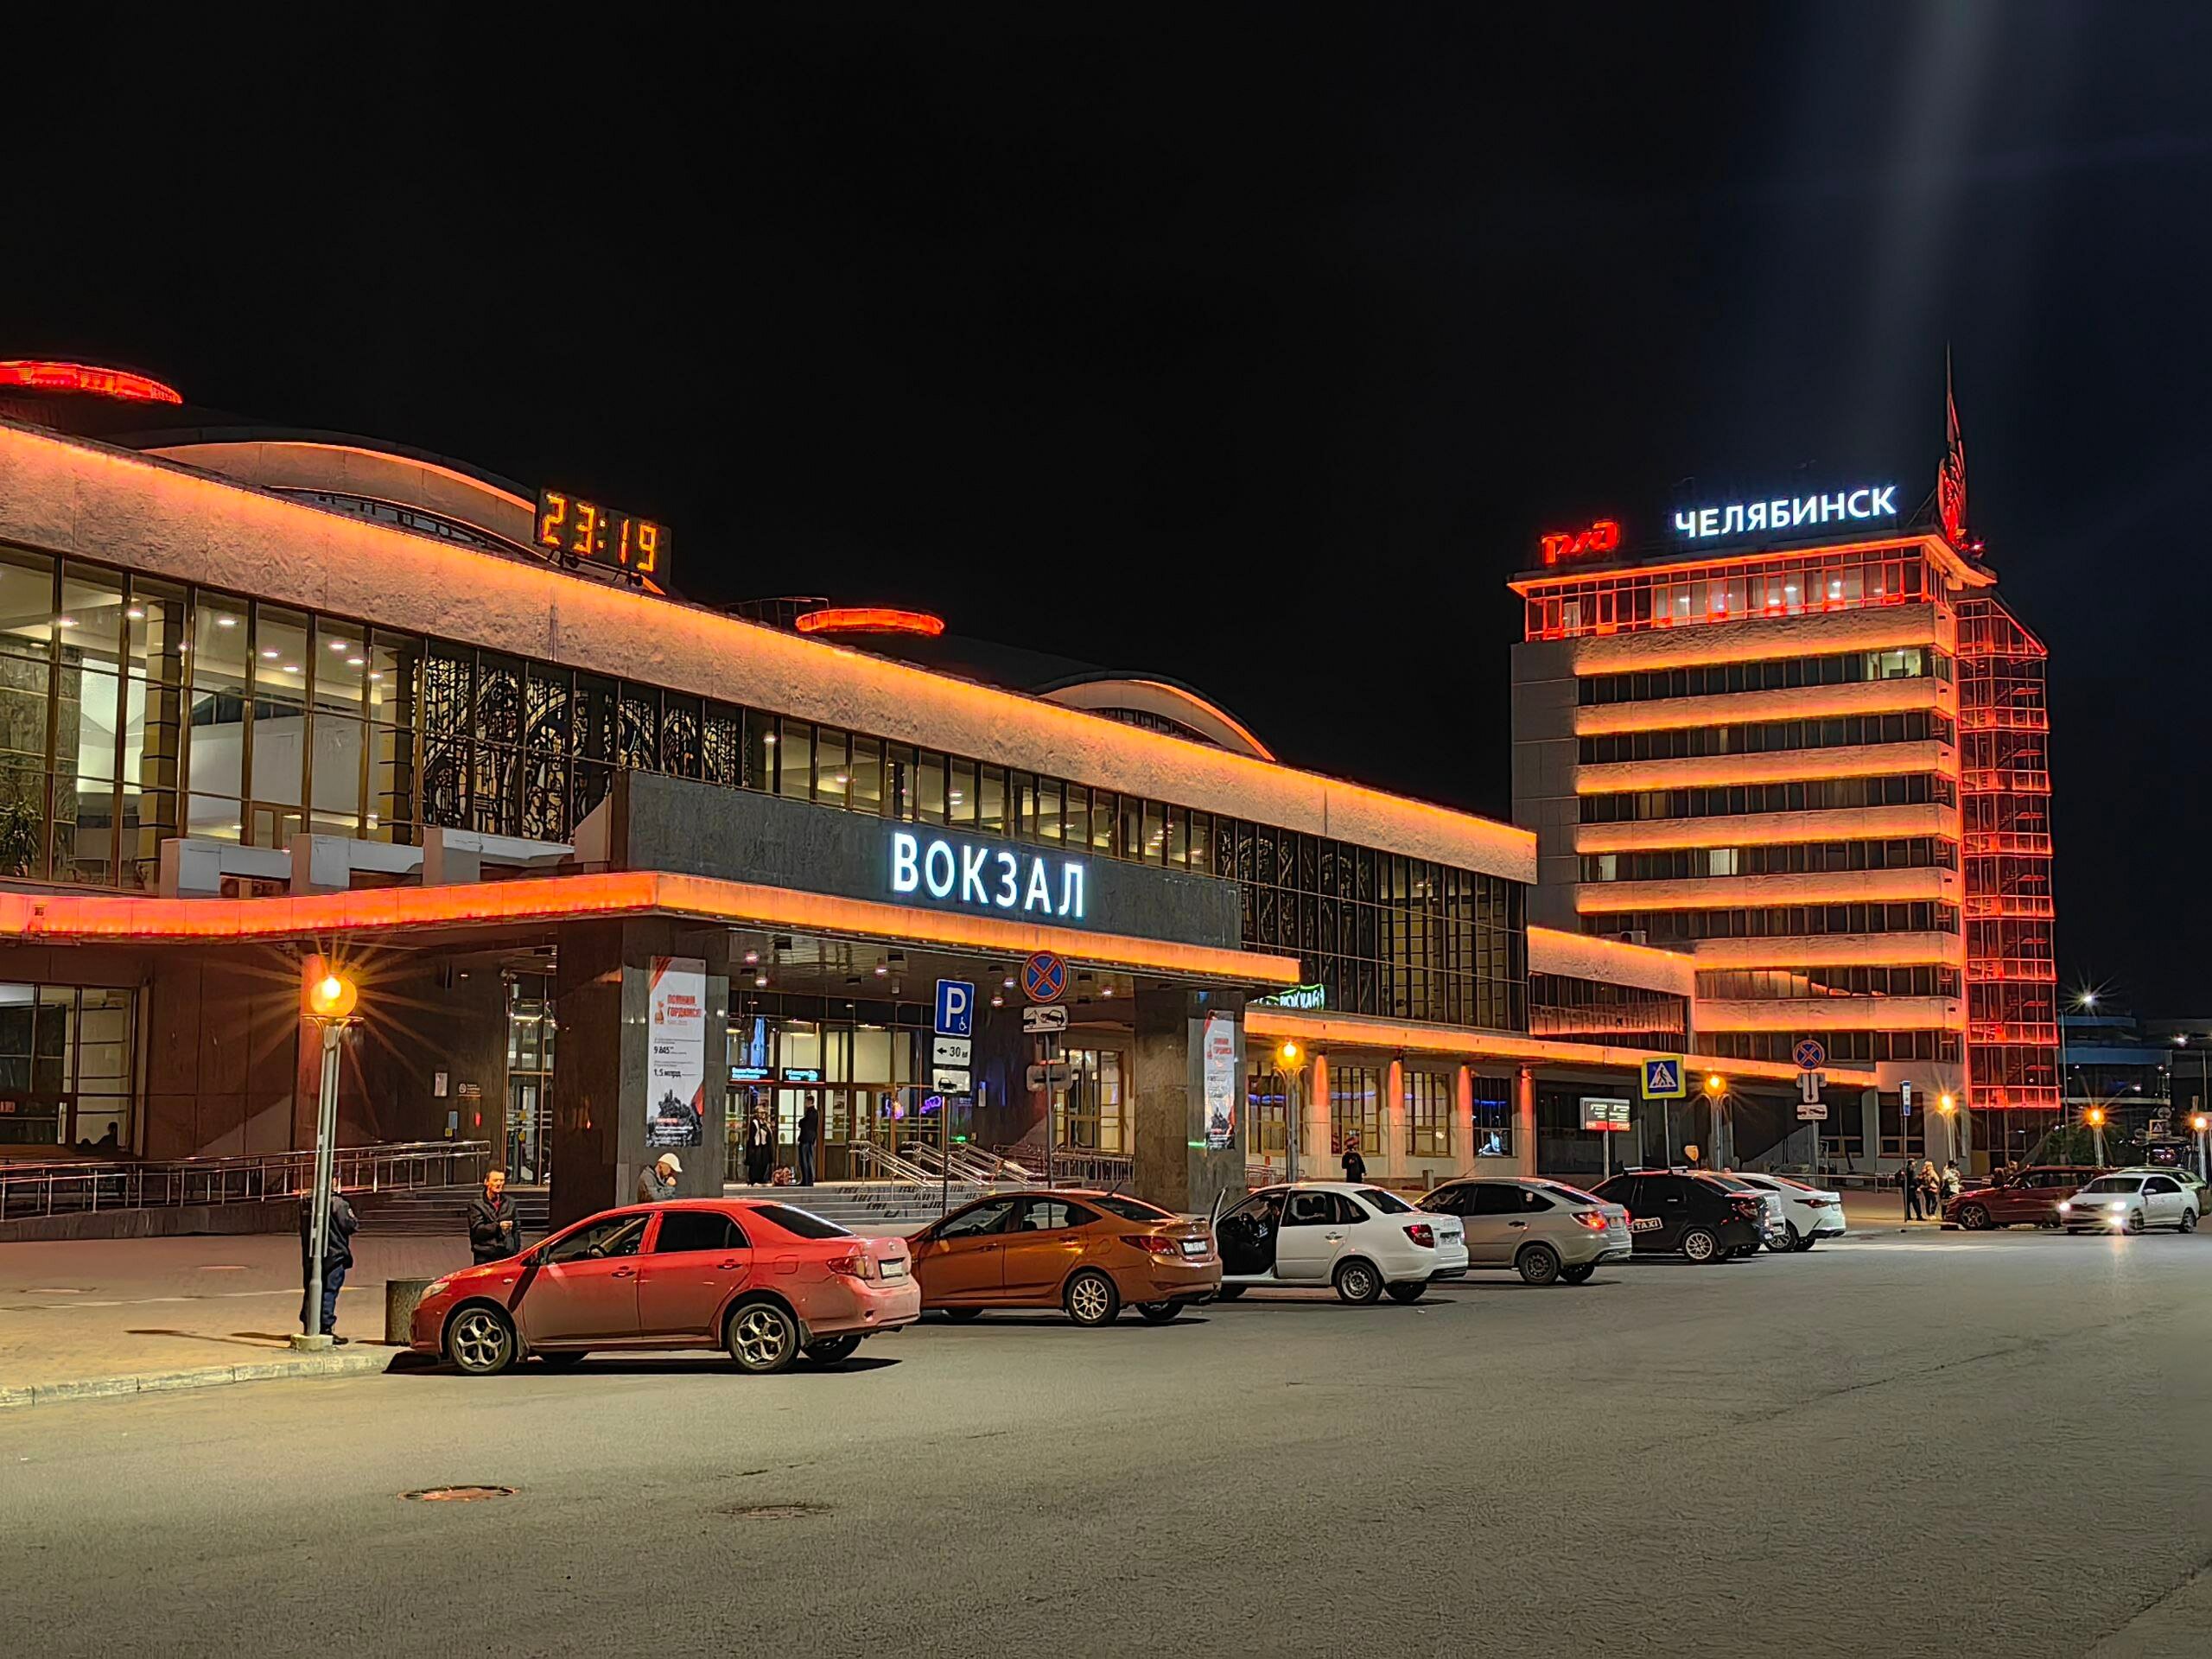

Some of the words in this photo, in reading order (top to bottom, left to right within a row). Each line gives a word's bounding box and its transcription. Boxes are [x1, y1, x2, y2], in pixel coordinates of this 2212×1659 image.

[543, 494, 657, 572] 23:19
[1675, 486, 1897, 537] ЧЕЛЯБИНСК
[893, 832, 1084, 918] ВОКЗАЛ
[950, 1046, 961, 1057] 30
[1636, 1220, 1658, 1230] TAXI
